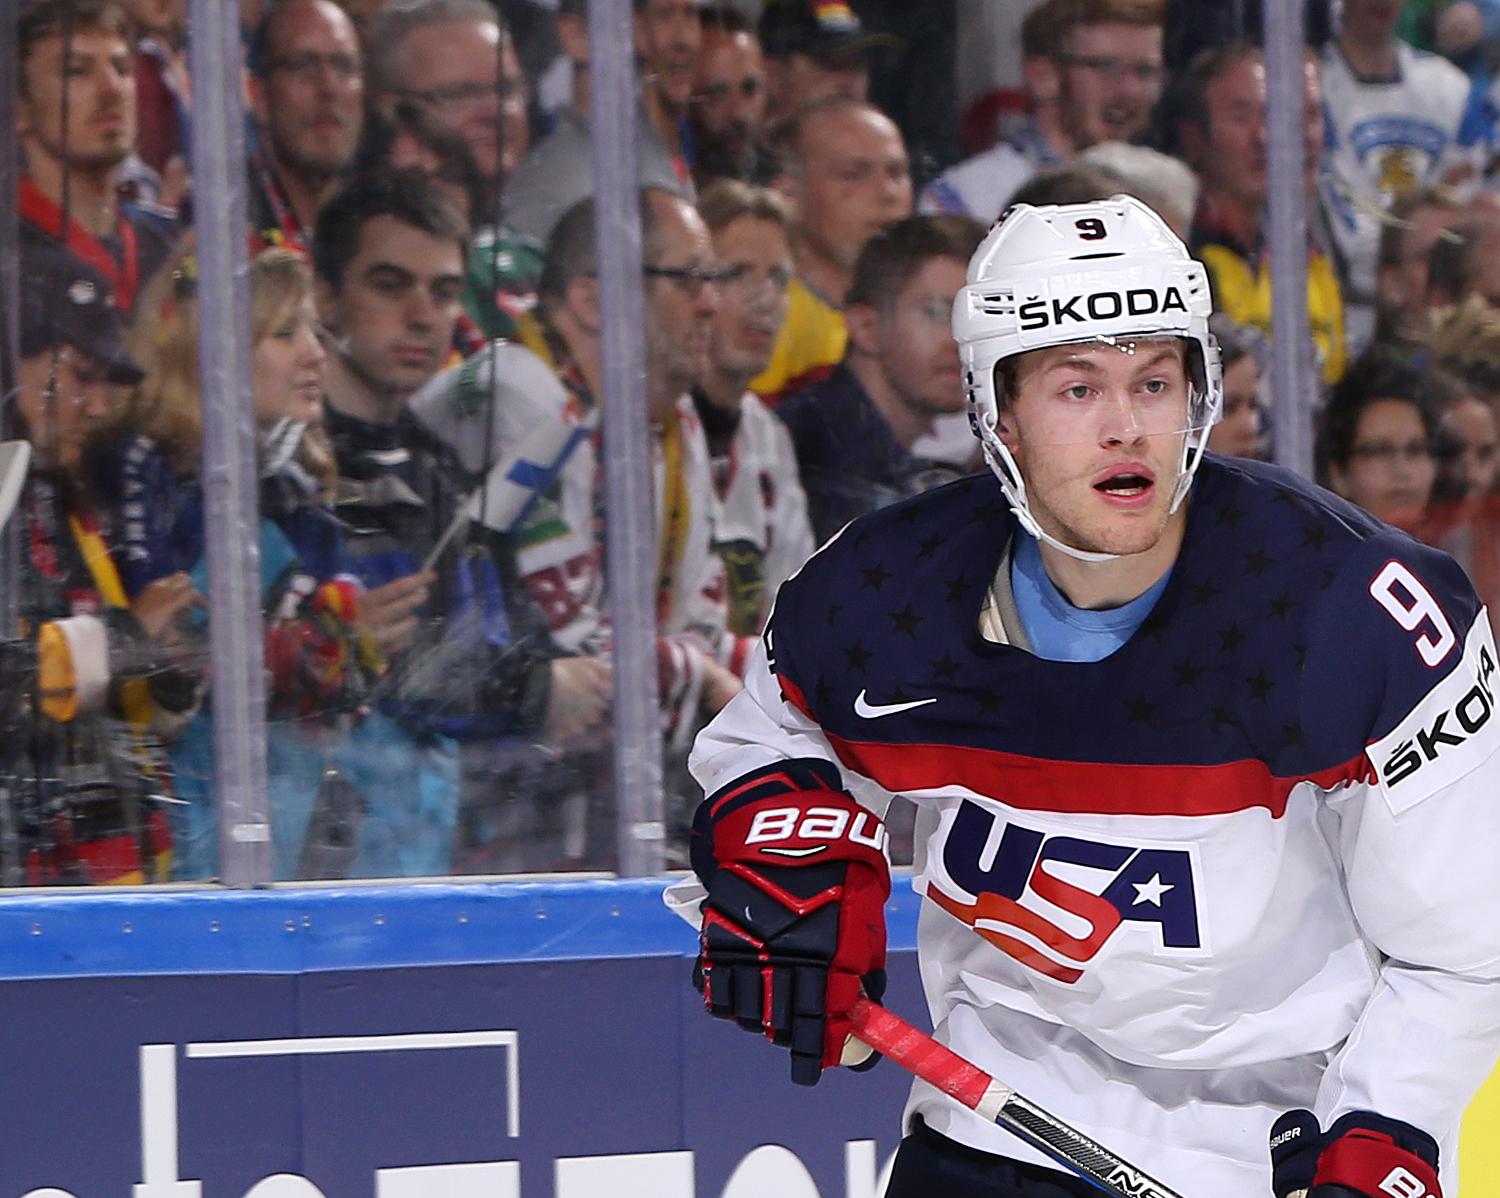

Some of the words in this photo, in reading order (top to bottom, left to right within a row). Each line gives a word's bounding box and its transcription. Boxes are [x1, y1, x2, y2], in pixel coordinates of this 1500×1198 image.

[1075, 218, 1107, 240] 9
[1019, 287, 1188, 331] ŠKODA
[1369, 560, 1456, 667] 9
[926, 798, 1200, 984] USA
